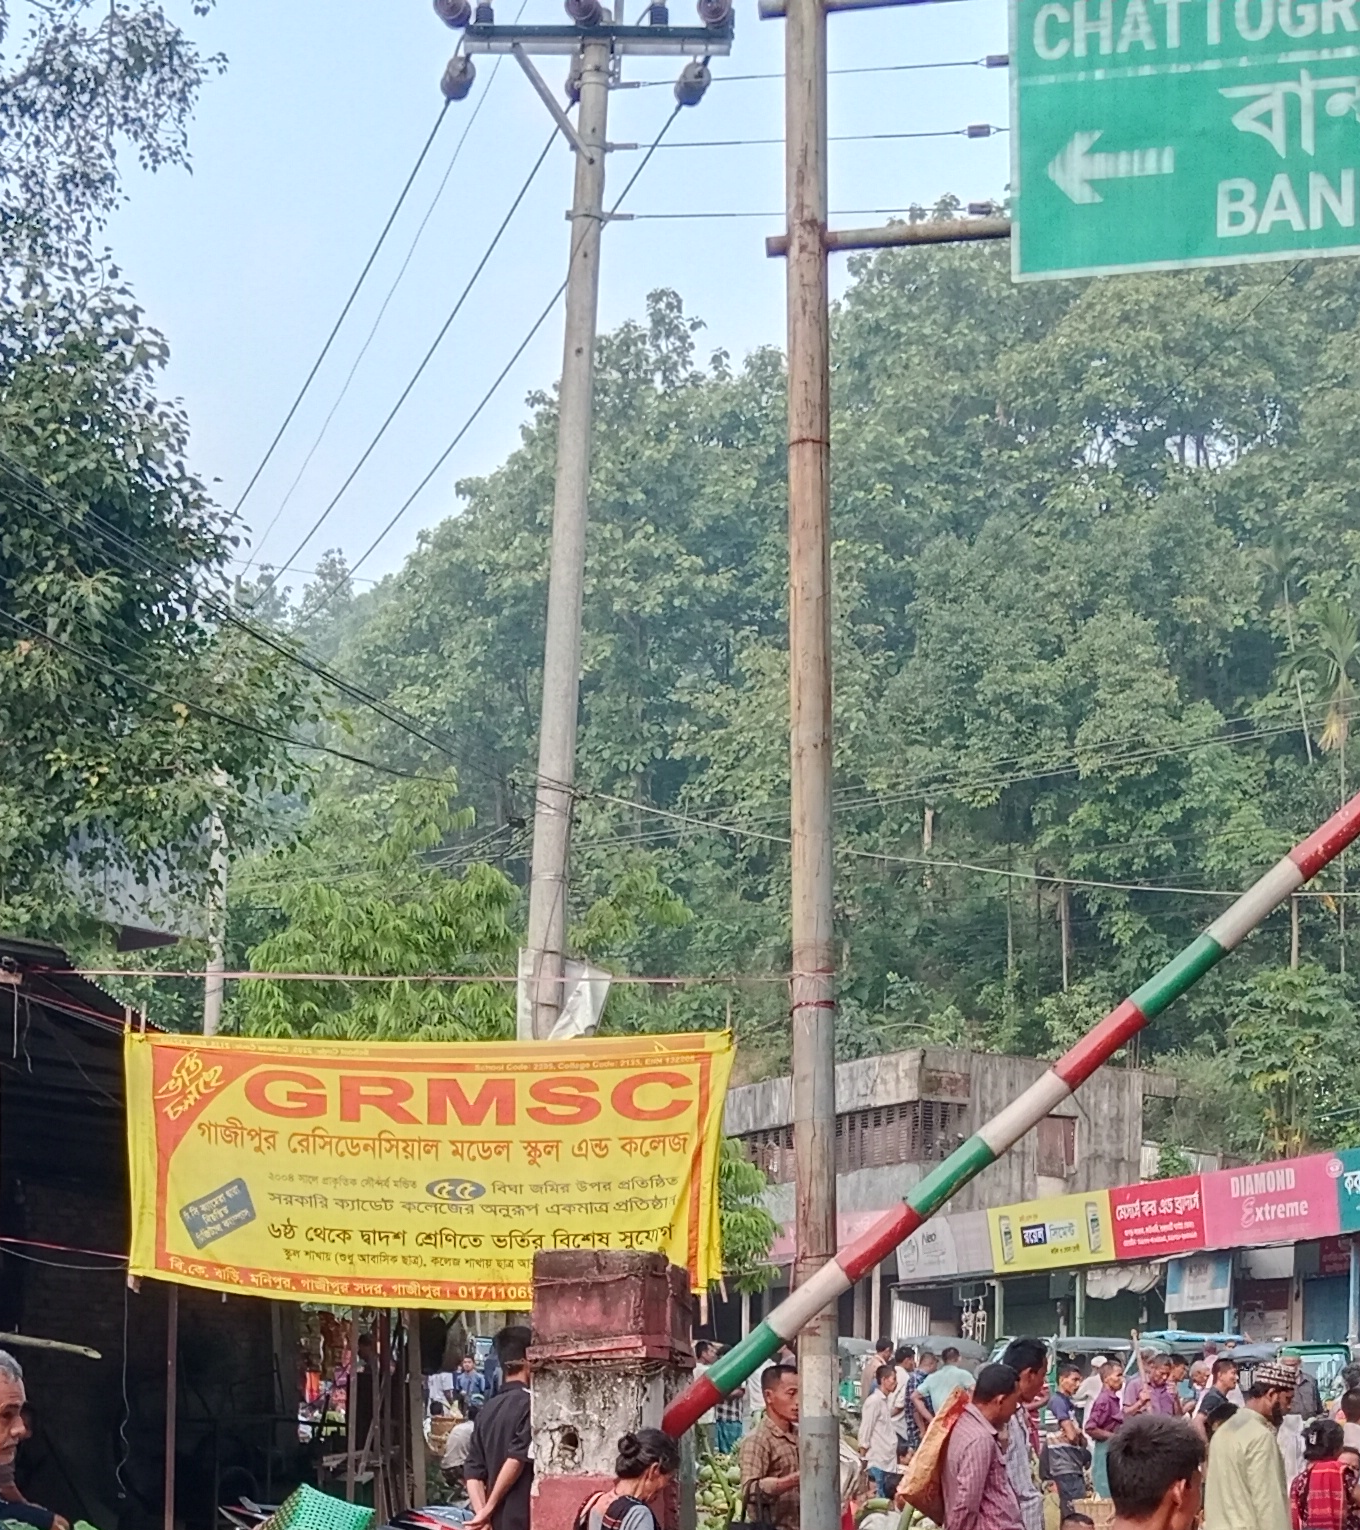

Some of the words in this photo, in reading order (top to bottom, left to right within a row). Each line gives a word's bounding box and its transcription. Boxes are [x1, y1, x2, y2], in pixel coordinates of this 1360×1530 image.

[244, 1070, 693, 1126] GRMSC
[198, 1116, 279, 1155] গাজীপুর
[288, 1126, 439, 1161] রেসিডেনসিয়াল
[449, 1139, 513, 1162] মডেল
[520, 1139, 563, 1168] স্কুল
[619, 1132, 690, 1158] কলেজ
[297, 1174, 319, 1185] সালে
[433, 1181, 477, 1200] ৫৫
[492, 1180, 524, 1195] বিঘা
[529, 1180, 571, 1194] জমির
[576, 1178, 612, 1193] উপর
[618, 1174, 680, 1190] প্রতিষ্ঠিত
[1230, 1168, 1295, 1198] DIAMOND
[268, 1192, 329, 1209] সরকারি
[333, 1197, 394, 1212] ক্যাডেট
[399, 1200, 475, 1215] কলেজের
[545, 1201, 610, 1216] একমাত্র
[1240, 1197, 1308, 1228] Extreme
[268, 1217, 298, 1240] ৬ষ্ঠ
[305, 1225, 353, 1245] থেকে
[358, 1228, 408, 1247] দ্বাদশ
[415, 1227, 485, 1250] শ্রেণিতে
[491, 1228, 545, 1250] ভর্তির
[551, 1228, 612, 1250] বিশেষ
[617, 1222, 675, 1250] সুযোগ
[282, 1248, 301, 1262] স্কুল
[357, 1251, 399, 1266] আবাসিক
[430, 1257, 461, 1268] কলেজ
[496, 1258, 515, 1270] ছাত্র
[300, 1276, 349, 1295] গাজীপুর
